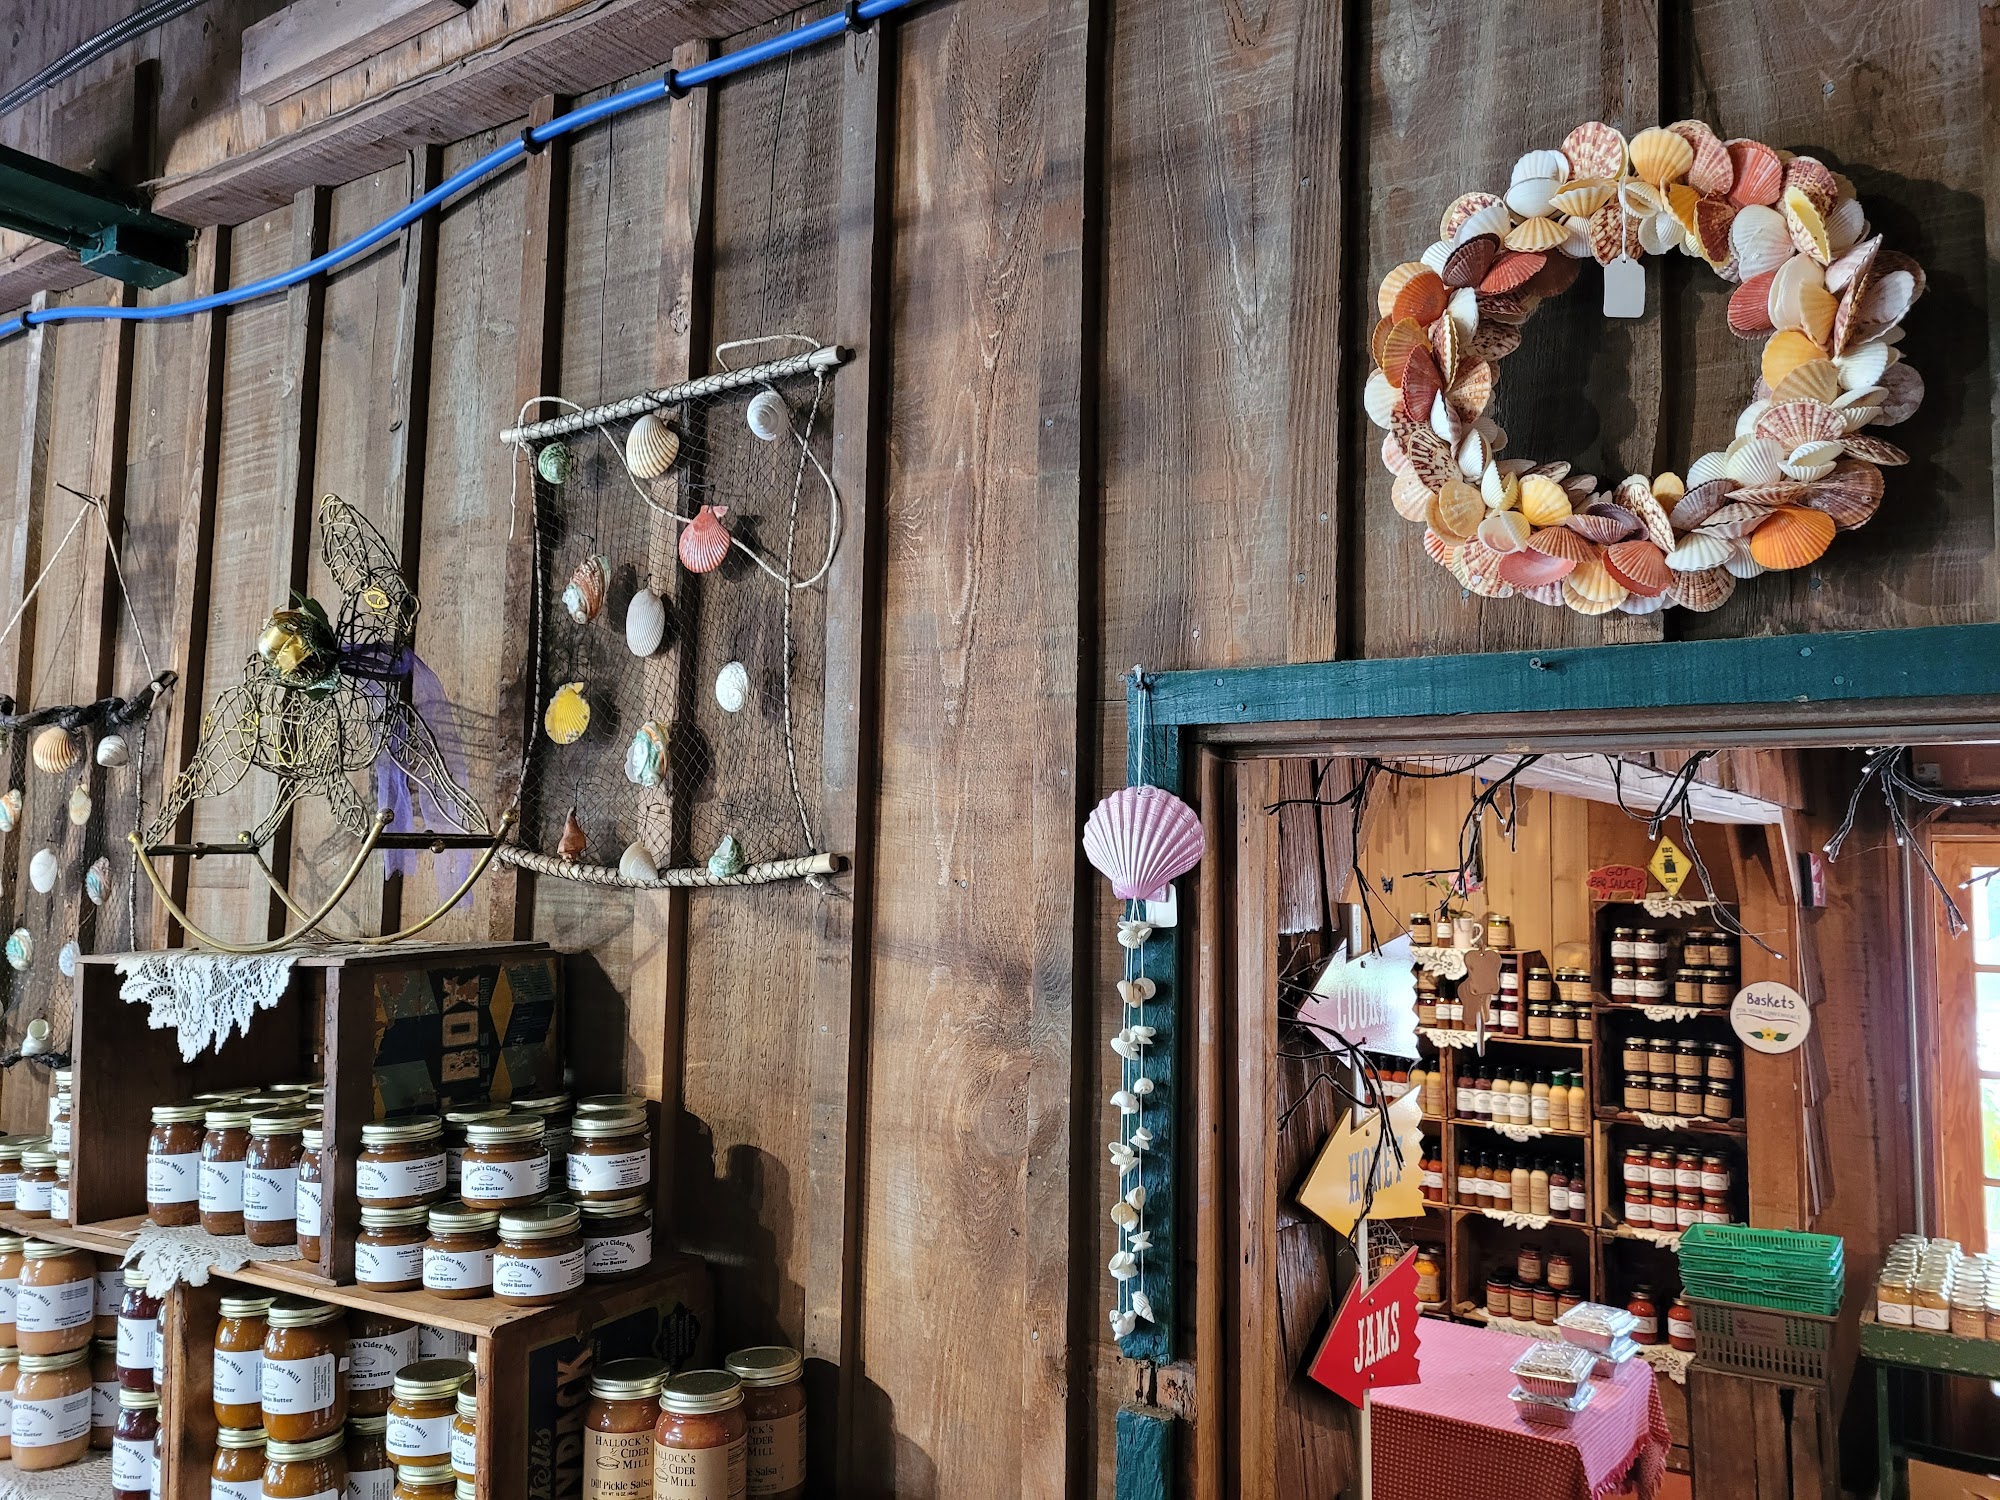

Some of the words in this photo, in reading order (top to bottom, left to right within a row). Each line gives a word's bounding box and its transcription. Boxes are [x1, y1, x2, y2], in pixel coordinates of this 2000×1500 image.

[1661, 846, 1673, 854] BBQ
[1605, 867, 1629, 876] GOT
[1589, 877, 1607, 887] BBQ
[1609, 876, 1643, 891] SAUCE?
[1746, 992, 1796, 1010] Baskets
[155, 1157, 171, 1167] Cider
[171, 1162, 185, 1176] Mill
[203, 1164, 216, 1175] Cder
[216, 1169, 230, 1184] Mill
[364, 1165, 378, 1174] Cider
[377, 1168, 388, 1183] Mill
[466, 1165, 485, 1180] llock's
[486, 1165, 502, 1174] Cider
[502, 1169, 514, 1182] Mill
[582, 1161, 592, 1176] Mill
[1347, 1135, 1404, 1206] HONEY
[252, 1172, 268, 1184] Cider
[268, 1179, 283, 1193] Mill
[298, 1184, 311, 1196] Cider
[626, 1242, 636, 1254] Mill
[370, 1254, 380, 1267] Mill
[440, 1254, 455, 1264] Cider
[455, 1260, 468, 1273] Mill
[514, 1260, 530, 1270] Cider
[530, 1265, 543, 1279] Mill
[4, 1286, 17, 1299] Mill
[24, 1288, 38, 1298] Cider
[38, 1294, 51, 1307] Mill
[124, 1326, 134, 1342] Mill
[431, 1328, 445, 1341] Mill
[1353, 1300, 1400, 1374] JAMS
[362, 1341, 384, 1349] Cider
[384, 1344, 398, 1357] Mill
[217, 1352, 230, 1364] Cider
[230, 1360, 244, 1376] Mill
[270, 1362, 286, 1374] Cider
[286, 1368, 302, 1384] Mill
[368, 1370, 390, 1378] Butter
[102, 1390, 114, 1403] Mill
[22, 1404, 40, 1412] Cider
[40, 1408, 54, 1421] Mill
[400, 1420, 415, 1430] Cider
[415, 1424, 428, 1440] Mill
[460, 1436, 473, 1446] Cider
[595, 1434, 650, 1448] HALLOCK'S
[746, 1436, 774, 1446] CIDER
[118, 1442, 132, 1454] Cider
[132, 1450, 146, 1464] Mill
[620, 1448, 650, 1459] CIDER
[748, 1447, 774, 1456] MILL
[622, 1458, 650, 1470] MILL
[668, 1464, 696, 1475] CIDER
[755, 1467, 777, 1476] Salsa
[349, 1480, 361, 1495] Mill
[590, 1478, 602, 1488] Dill
[604, 1480, 628, 1490] Pickle
[630, 1478, 652, 1490] Salsa
[670, 1476, 697, 1487] MILL
[218, 1484, 234, 1496] Cider
